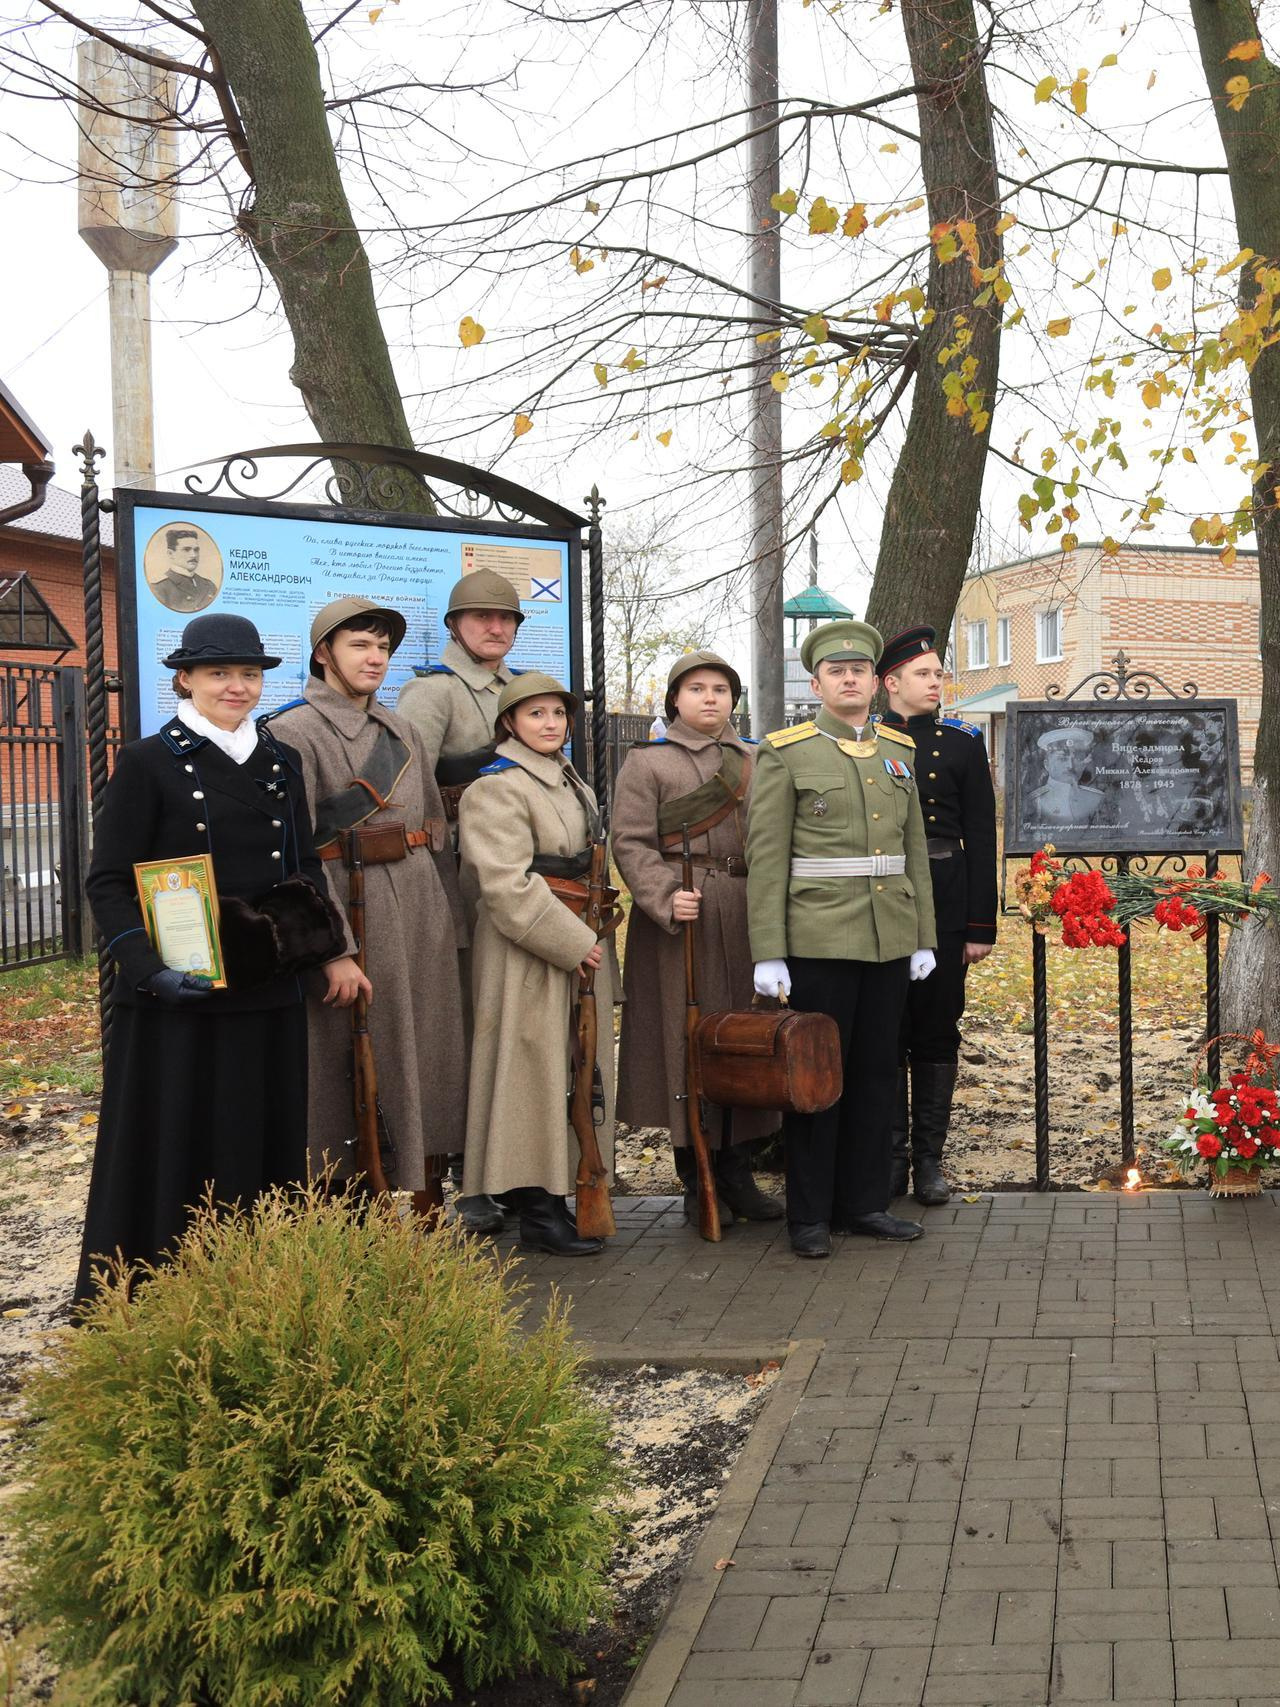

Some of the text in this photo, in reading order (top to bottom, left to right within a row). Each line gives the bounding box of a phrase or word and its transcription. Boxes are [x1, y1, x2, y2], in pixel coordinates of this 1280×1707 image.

[229, 549, 268, 560] КЕДРОВ
[229, 560, 270, 571] МИХАИЛ
[229, 572, 312, 585] АЛЕКСАНДРОВИЧ
[371, 594, 394, 602] между
[1111, 742, 1185, 754] Вице-адмирал
[1131, 754, 1164, 764] Кедров
[1095, 766, 1200, 776] Михаил Александрович
[1120, 780, 1142, 789] 1878
[1153, 780, 1175, 789] 1945
